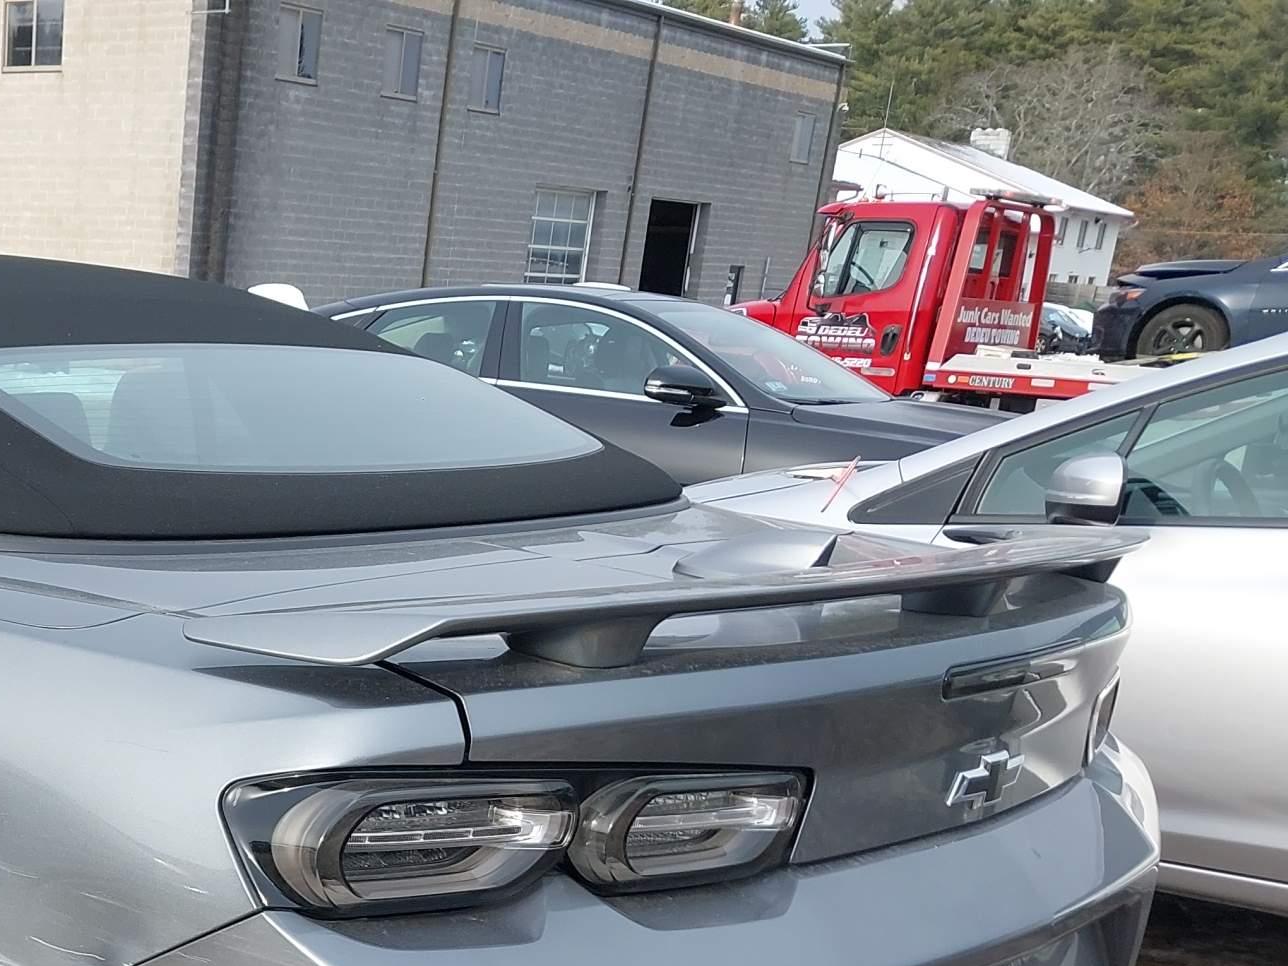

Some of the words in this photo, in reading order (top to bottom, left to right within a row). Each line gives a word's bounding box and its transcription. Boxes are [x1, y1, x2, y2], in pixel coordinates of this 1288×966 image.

[957, 305, 981, 327] Junk
[980, 307, 1000, 325] Cars
[1000, 309, 1033, 327] Wanted
[991, 329, 1021, 345] TOWING
[969, 375, 1016, 389] CENTURY
